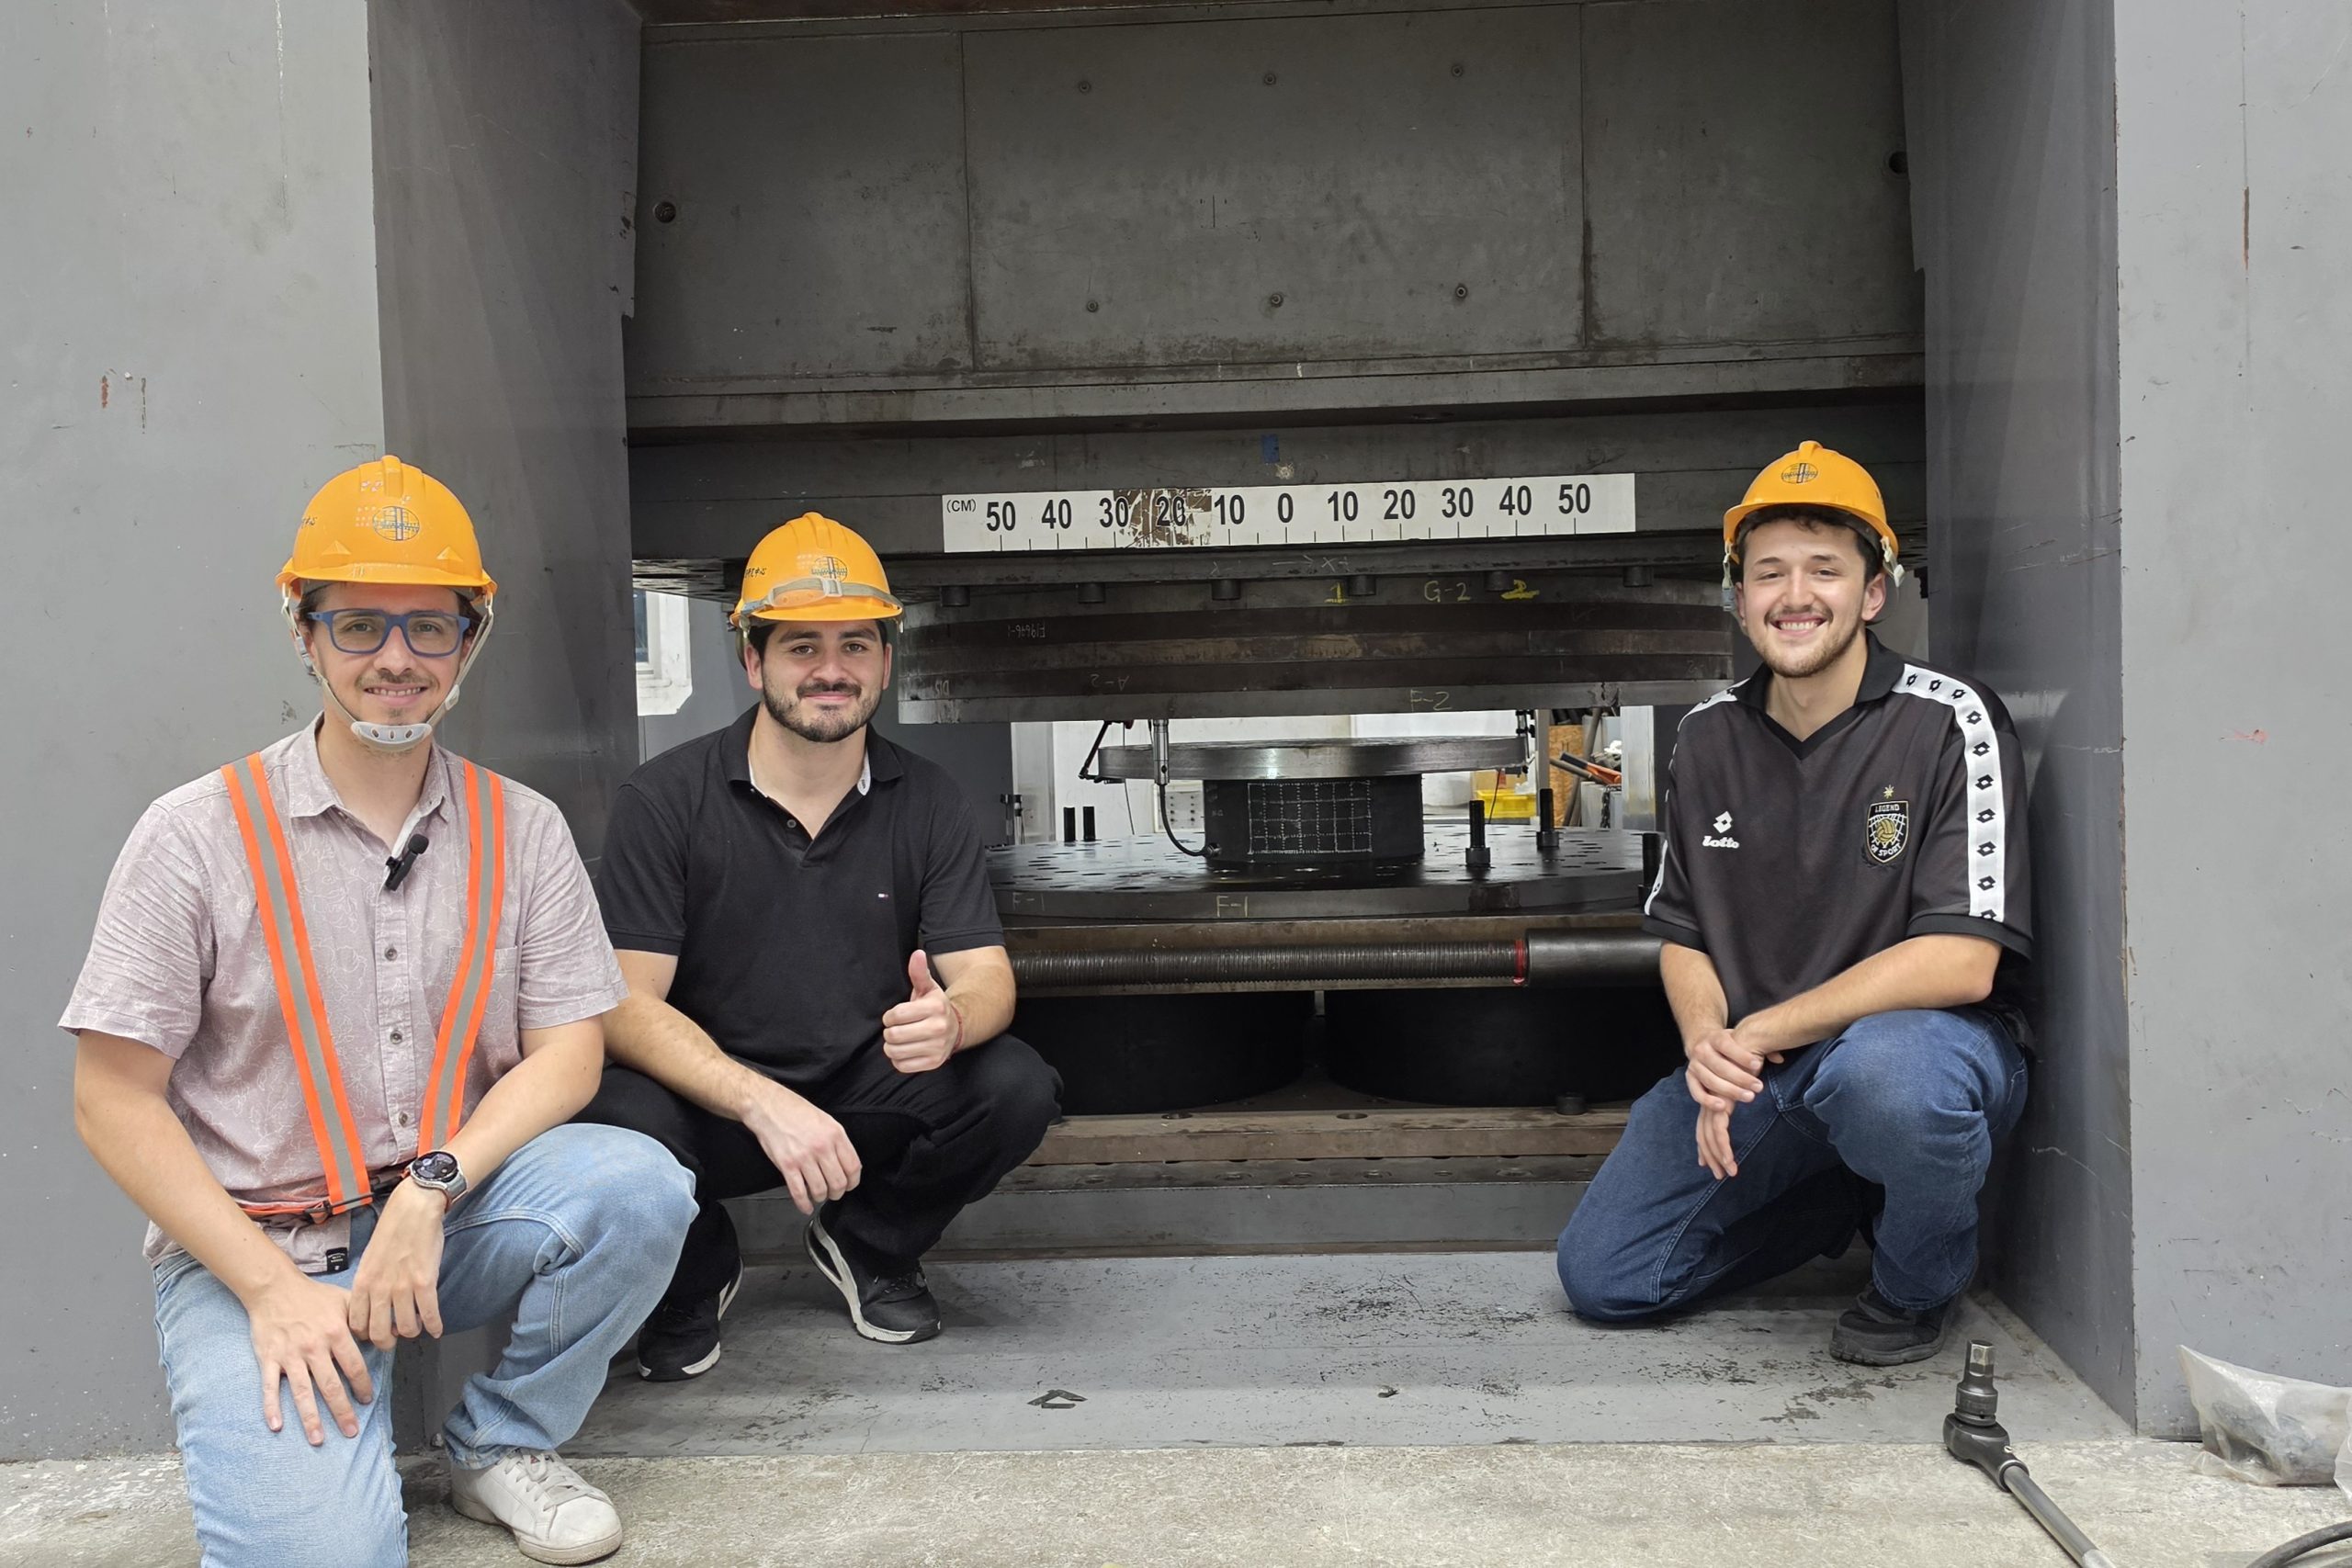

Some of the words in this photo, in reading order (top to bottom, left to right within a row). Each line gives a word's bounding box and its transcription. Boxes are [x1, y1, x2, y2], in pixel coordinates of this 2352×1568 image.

[946, 499, 977, 513] (CM)
[986, 502, 1016, 532] 50
[1041, 499, 1072, 530] 40
[1099, 497, 1129, 528] 30
[1156, 495, 1186, 527] 20
[1214, 494, 1245, 525] 10
[1277, 492, 1294, 524] 0
[1327, 491, 1359, 522] 10
[1383, 489, 1416, 520] 20
[1442, 487, 1474, 518] 30
[1498, 485, 1532, 515] 40
[1557, 482, 1591, 514] 50
[1423, 580, 1472, 603] G-2
[1408, 689, 1452, 712] F-2
[1874, 803, 1900, 814] LEGEND
[1878, 842, 1902, 857] SPORT
[1012, 892, 1046, 912] F-1
[1216, 895, 1249, 918] F-1
